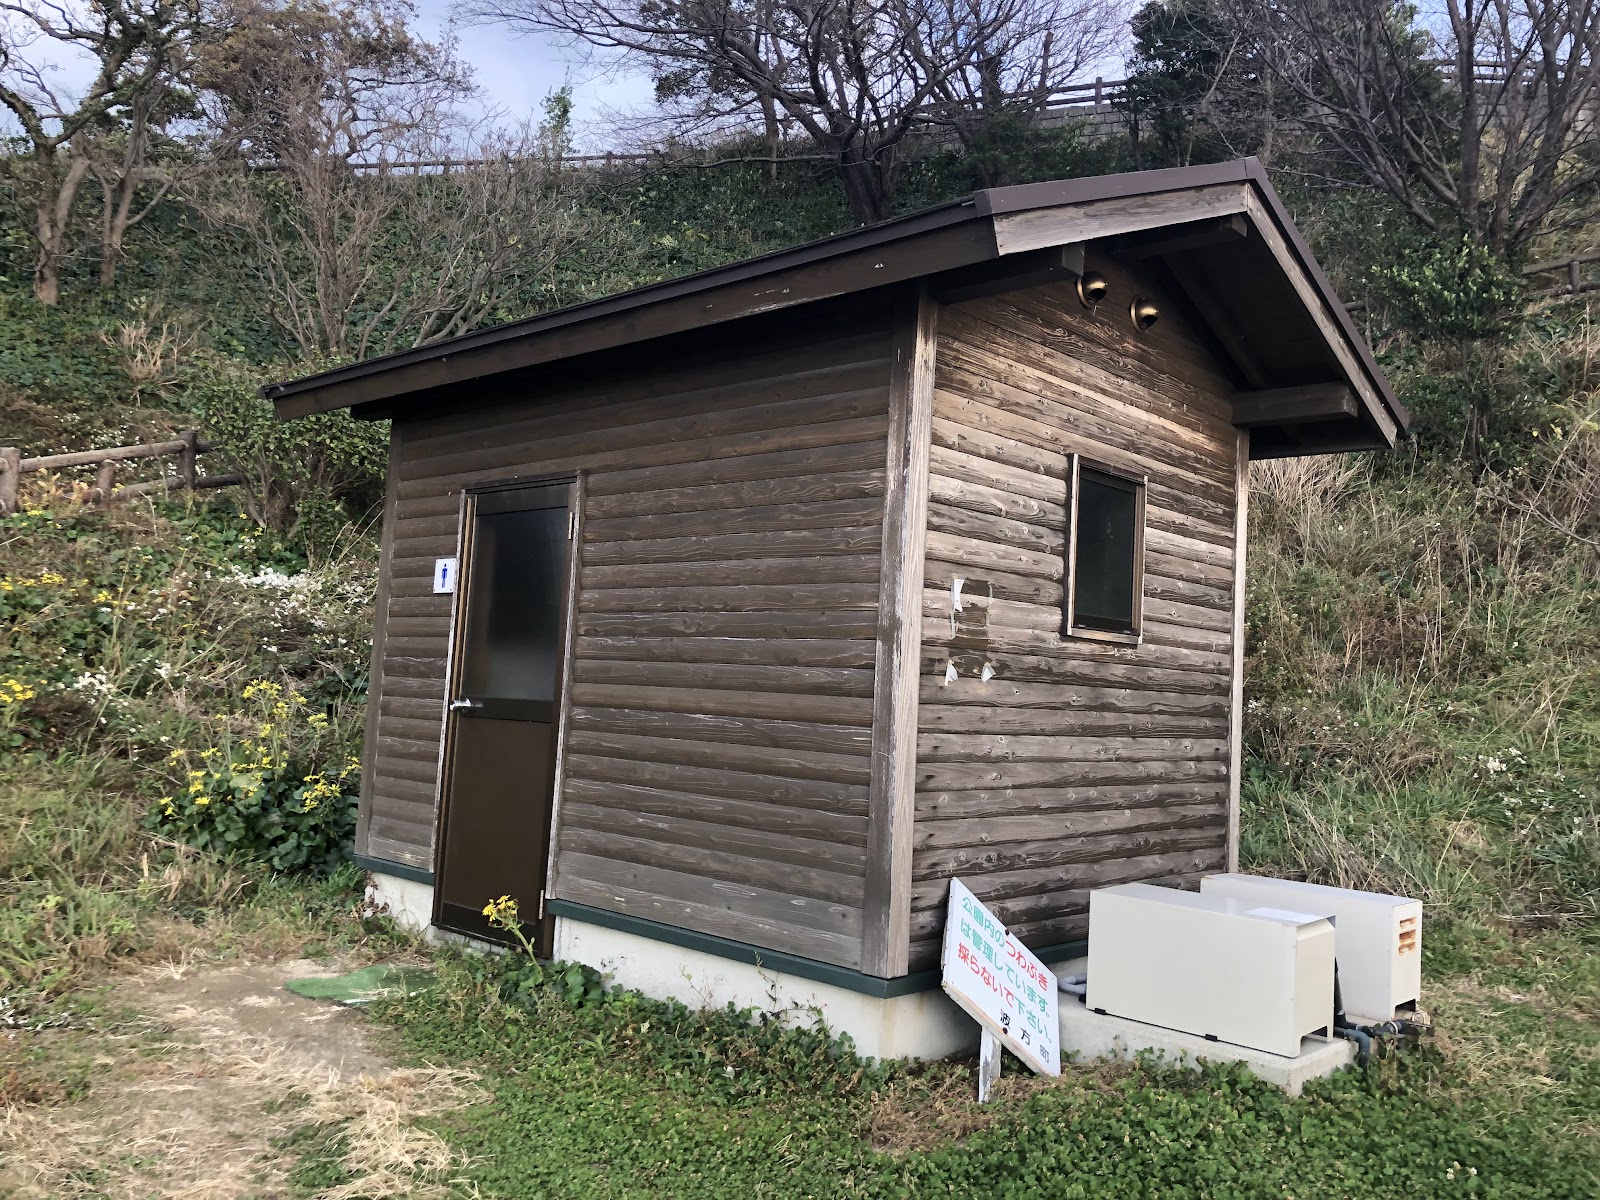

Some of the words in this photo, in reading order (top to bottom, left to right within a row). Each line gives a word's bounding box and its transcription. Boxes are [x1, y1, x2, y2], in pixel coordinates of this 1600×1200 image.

[957, 942, 1052, 1044] 採らないで下さい。
[960, 917, 1050, 1017] は管理しています。
[962, 896, 1048, 991] 公園内のつわぶき
